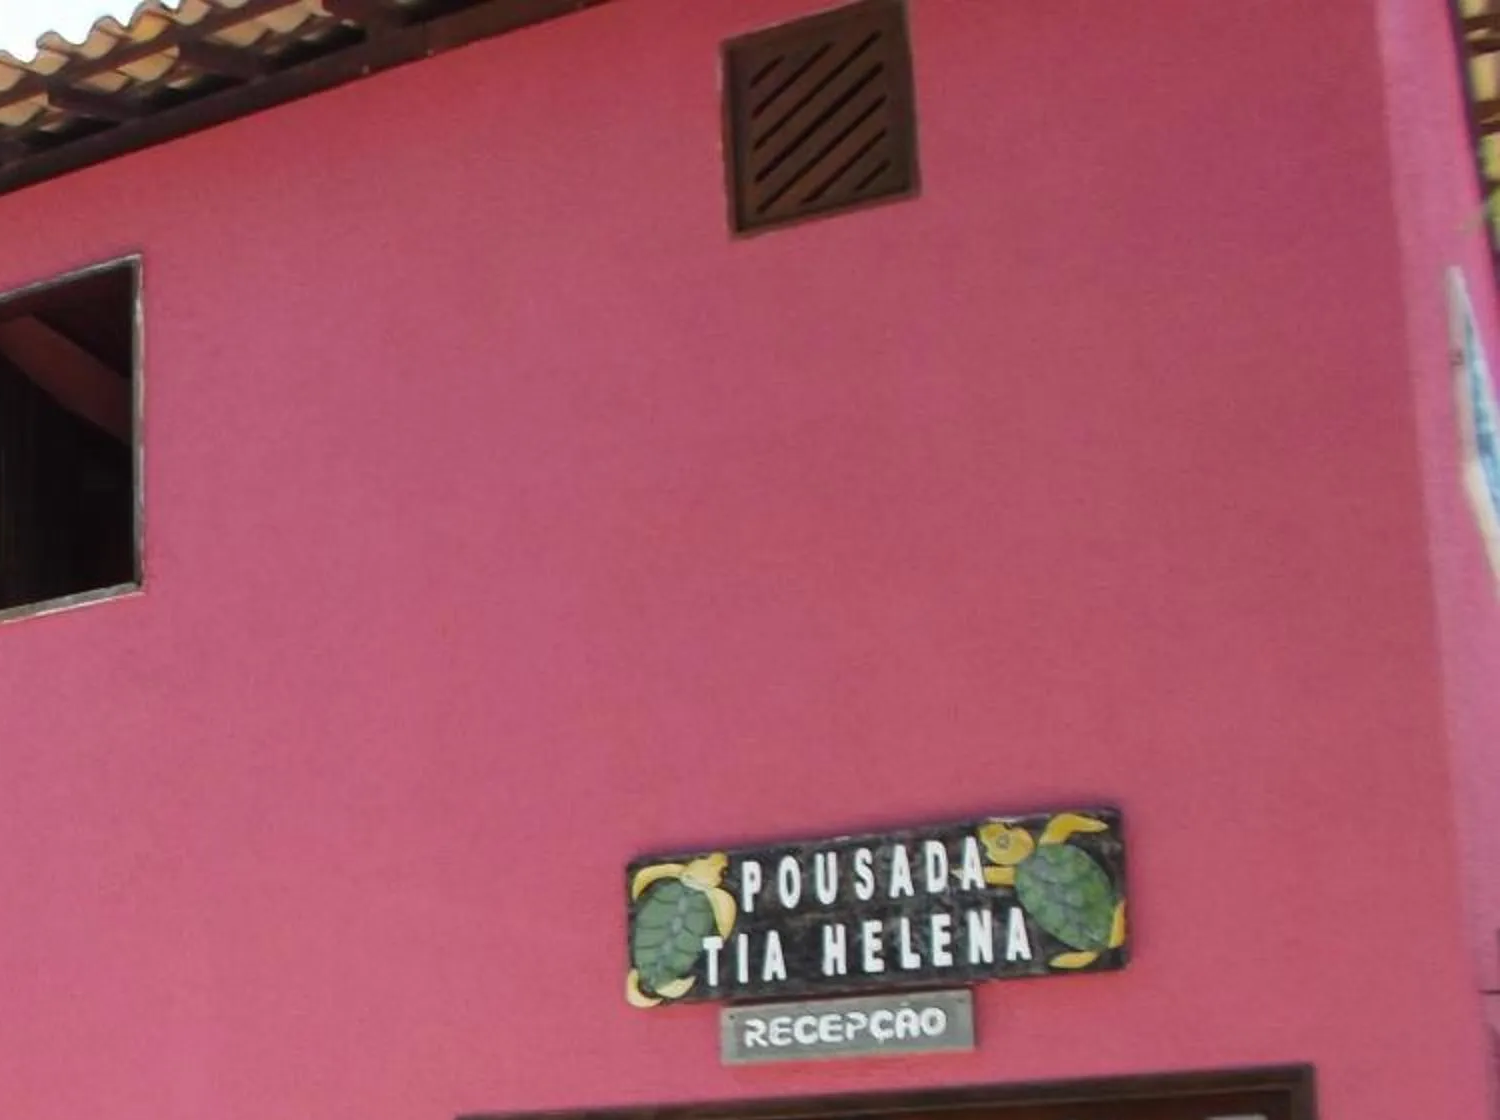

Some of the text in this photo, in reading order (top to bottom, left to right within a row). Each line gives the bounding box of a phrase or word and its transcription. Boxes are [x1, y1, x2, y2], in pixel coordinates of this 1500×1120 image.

[741, 836, 987, 913] POUSADA
[702, 907, 1033, 986] TIA HELENA
